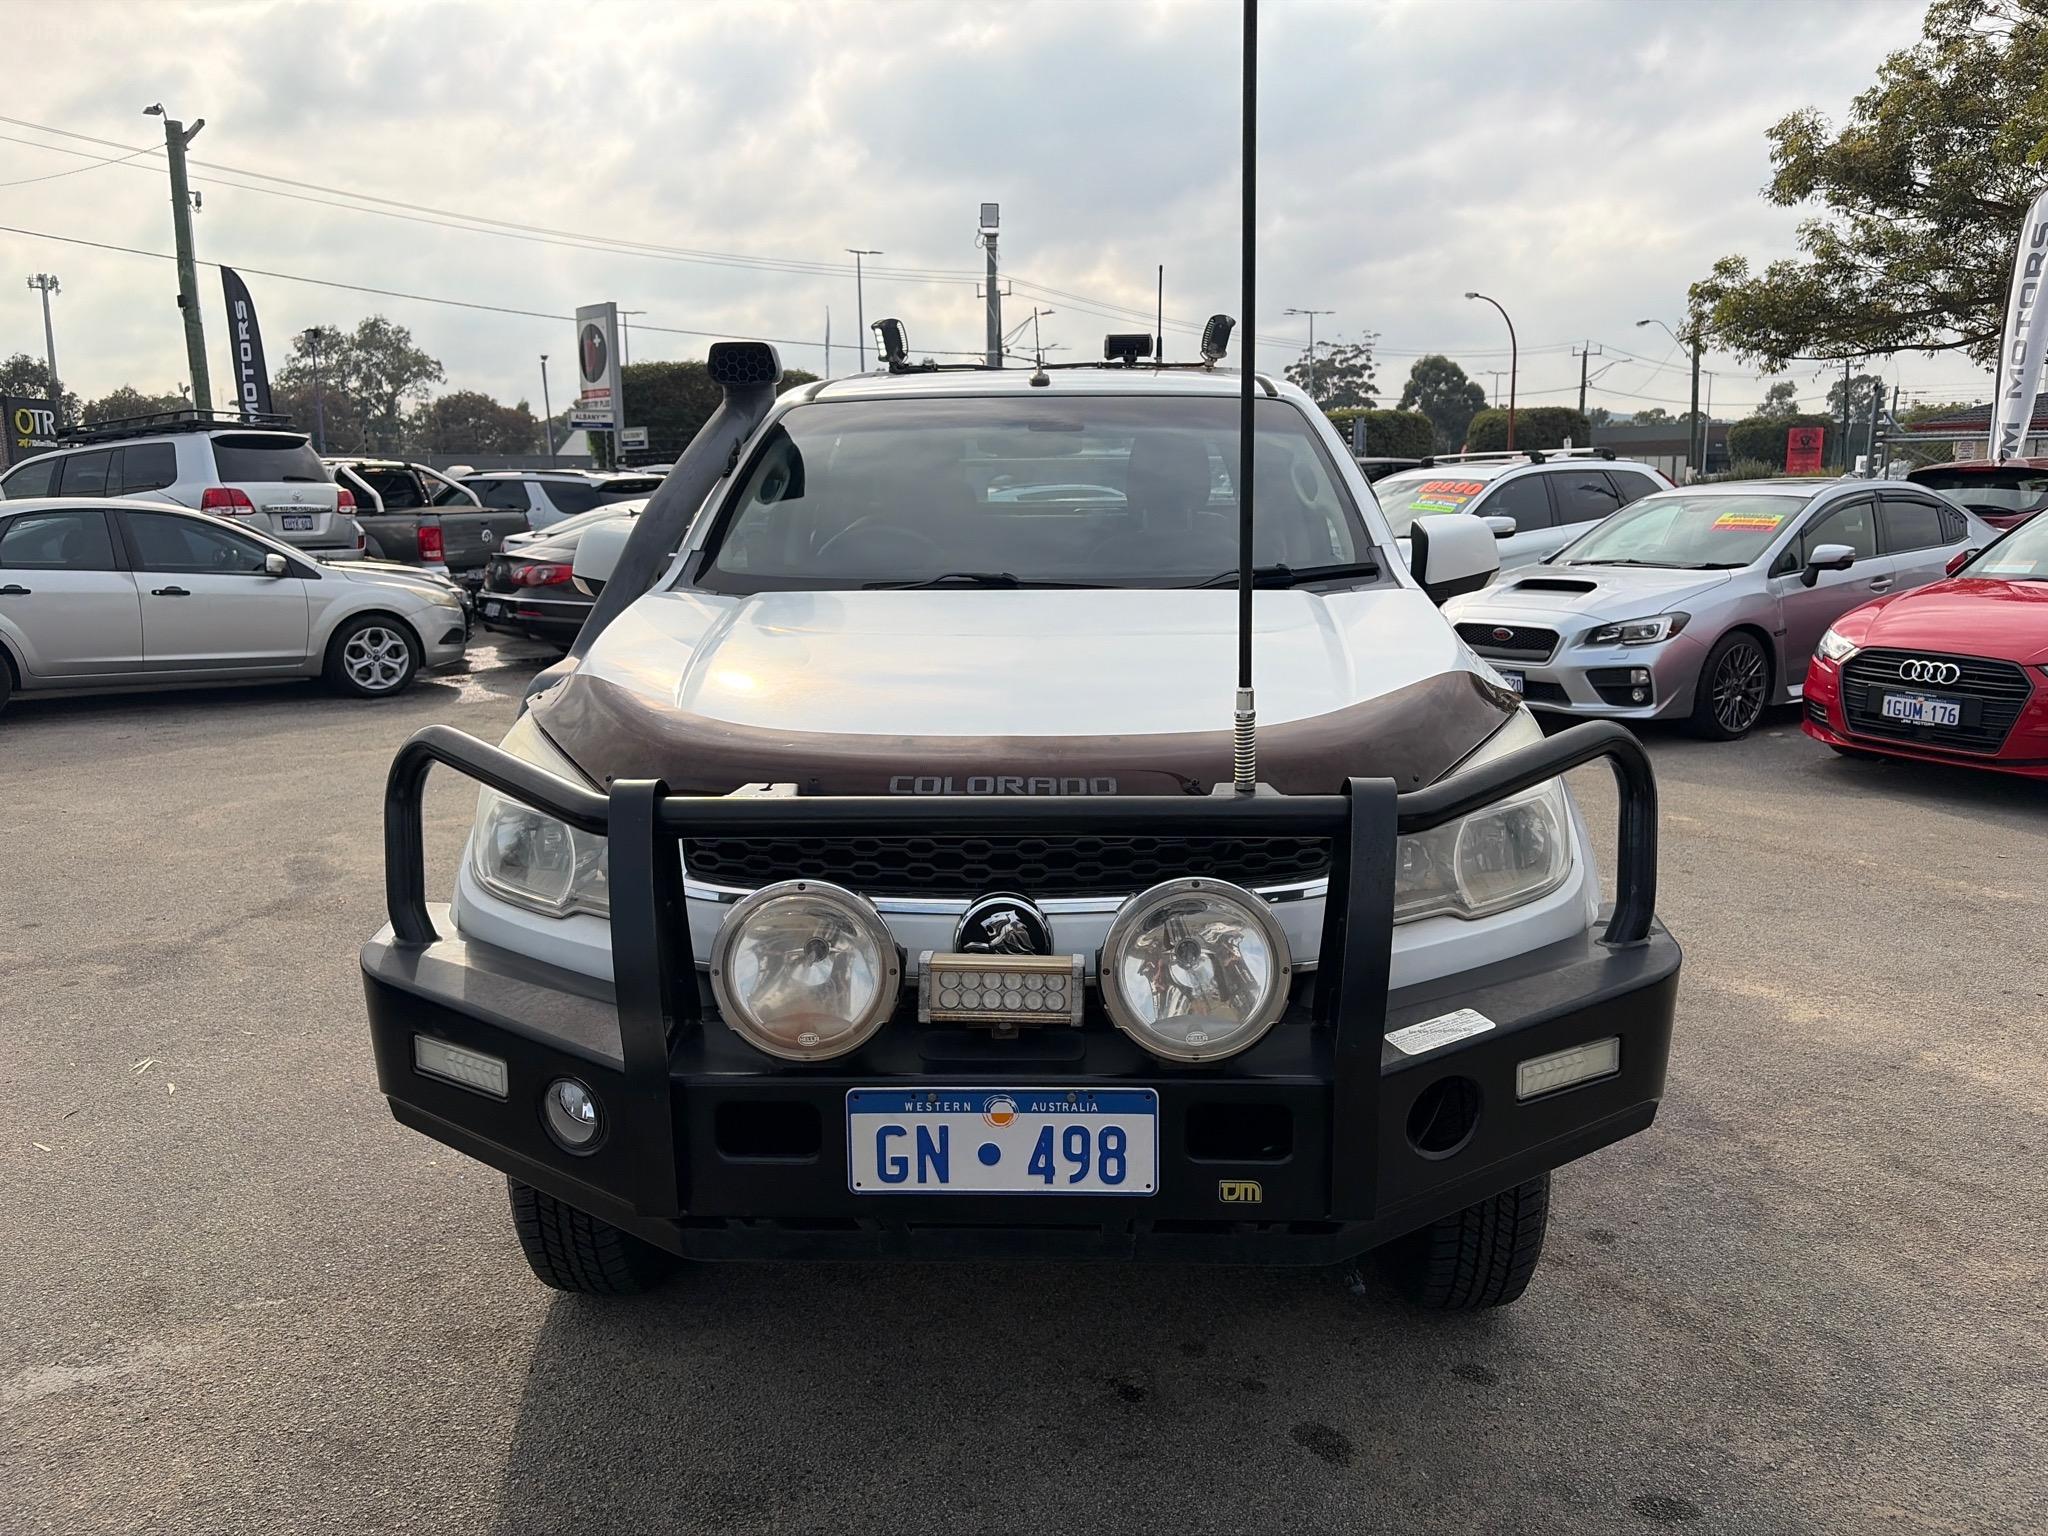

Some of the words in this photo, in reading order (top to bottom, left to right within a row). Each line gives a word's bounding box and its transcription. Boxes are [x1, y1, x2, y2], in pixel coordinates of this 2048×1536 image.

[2006, 222, 2048, 399] MOTORS
[234, 300, 261, 423] MOTORS
[15, 408, 56, 436] OTR
[575, 412, 600, 421] ALBANY
[1418, 480, 1484, 496] 19990
[1886, 699, 1923, 719] 1GUM
[1931, 705, 1957, 724] 176
[889, 775, 1117, 795] COLORADO
[904, 1101, 972, 1113] WESTERN
[1030, 1101, 1100, 1113] AUSTRALIA
[875, 1124, 950, 1185] GN
[1027, 1124, 1127, 1186] 498
[1220, 1182, 1261, 1201] TJM
